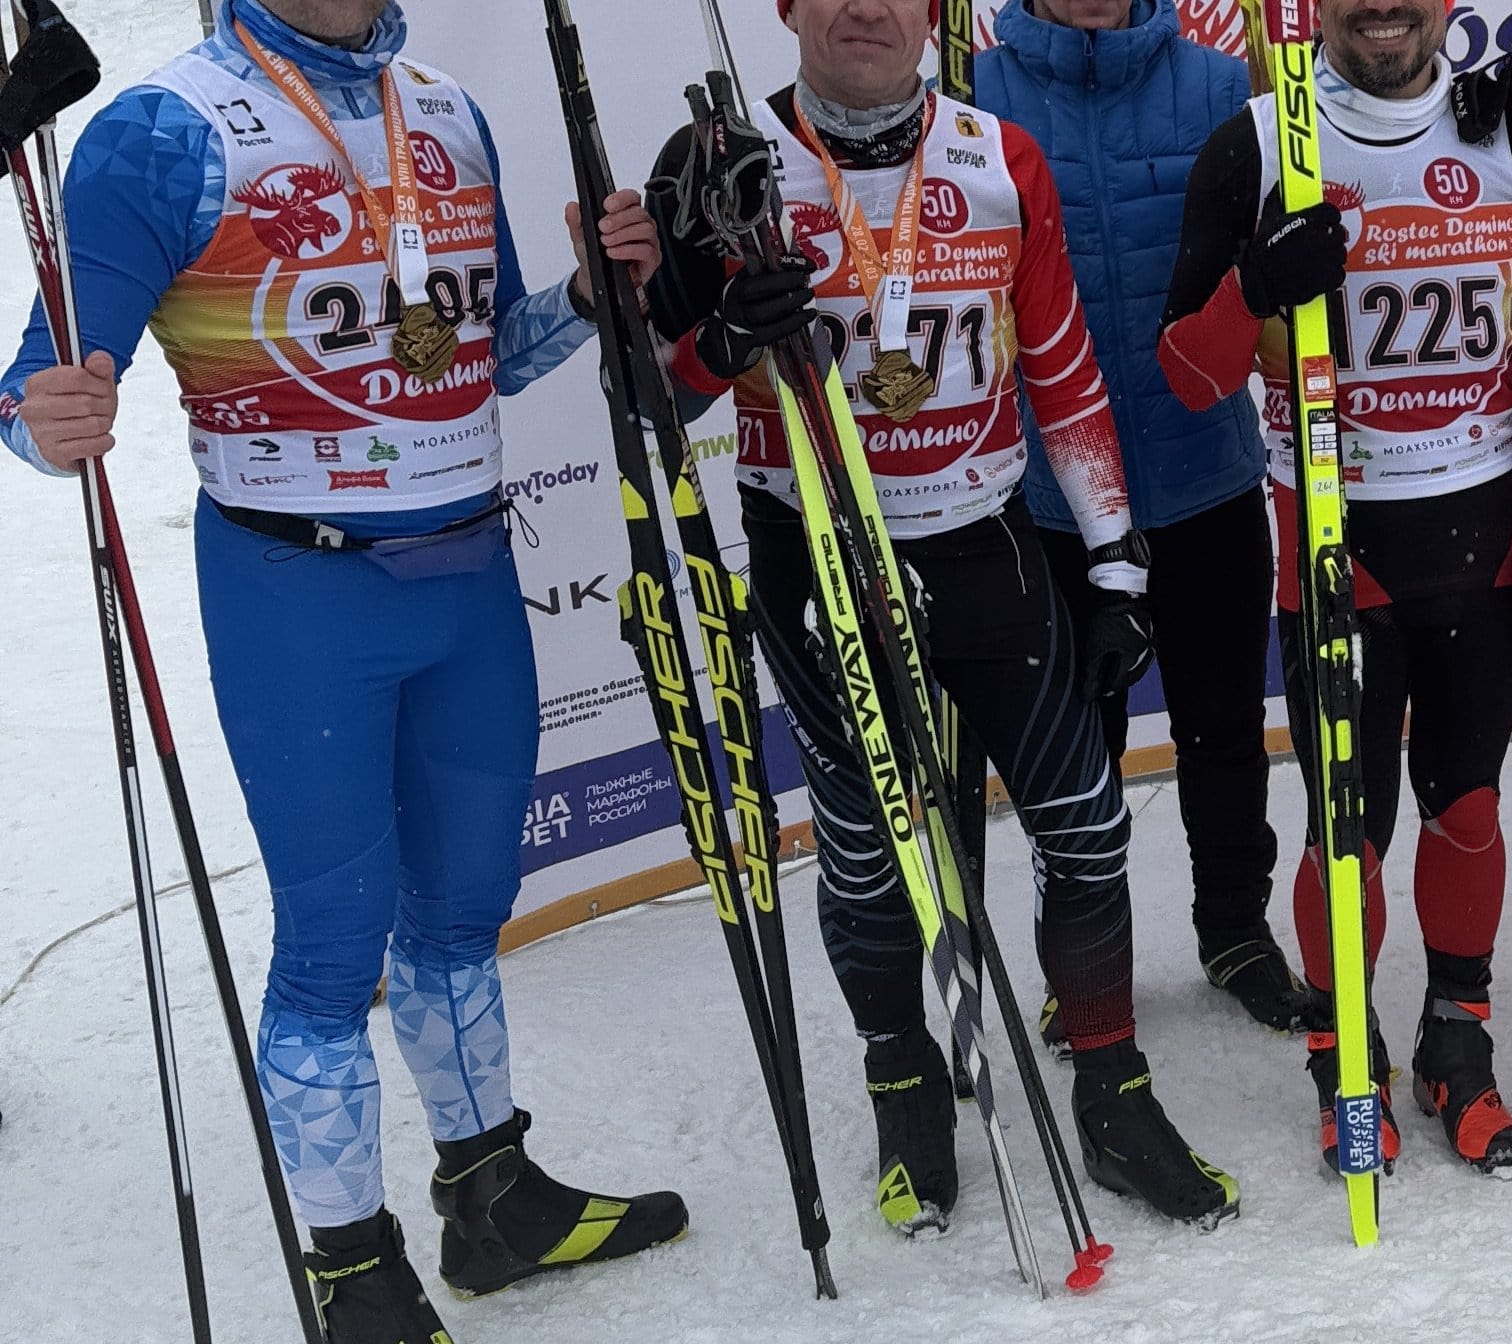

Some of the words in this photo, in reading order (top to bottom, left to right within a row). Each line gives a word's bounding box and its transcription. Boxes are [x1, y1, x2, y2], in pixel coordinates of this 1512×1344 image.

[411, 139, 446, 174] 50
[1434, 164, 1470, 196] 50
[397, 195, 416, 213] 50
[921, 185, 958, 219] 50
[1366, 221, 1441, 244] Rostec
[892, 248, 913, 263] 50
[931, 239, 1009, 263] Demino
[1364, 243, 1398, 267] ski
[1403, 239, 1509, 261] marathon
[911, 261, 1001, 287] arathon
[1348, 382, 1484, 417] Демино
[412, 421, 490, 450] MOAXSPORT
[1383, 435, 1460, 457] MOAXSPORT
[502, 460, 599, 499] ayToday
[876, 480, 959, 498] OAXSPORT
[833, 620, 879, 733] WAY
[540, 686, 599, 710] ионерное
[684, 551, 775, 914] FISCHER
[635, 569, 740, 927] FISCHER
[584, 767, 654, 799] ЛЫЖНЫЕ
[586, 775, 673, 813] МАРАФОНЫ
[864, 731, 913, 843] ONE
[587, 798, 647, 827] РОССИИ
